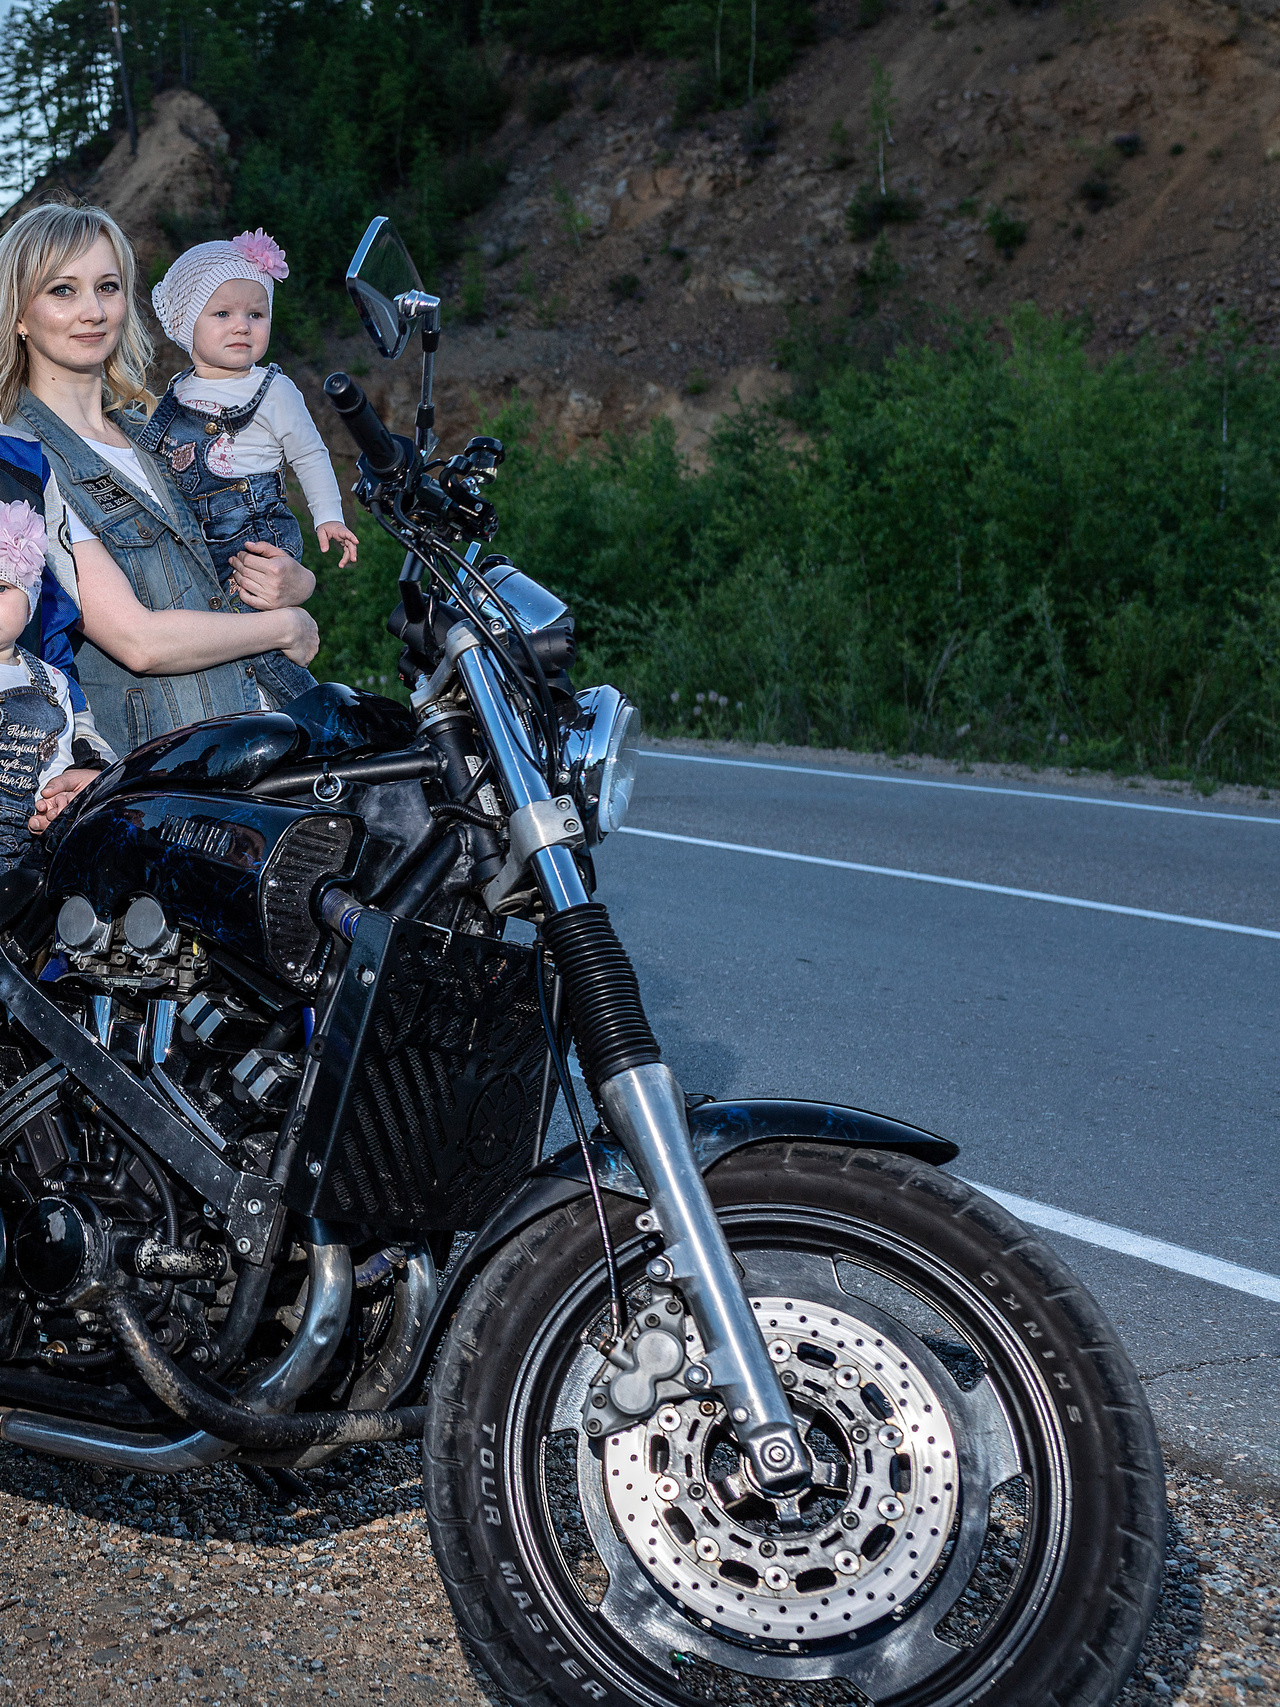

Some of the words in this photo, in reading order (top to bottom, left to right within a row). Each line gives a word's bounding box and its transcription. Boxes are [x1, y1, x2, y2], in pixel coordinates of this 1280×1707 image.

[96, 476, 112, 488] TR
[95, 492, 116, 503] FUCK
[114, 494, 134, 506] ECO
[160, 813, 233, 857] YAMAHA
[980, 1271, 1083, 1424] SHINKO
[479, 1422, 503, 1527] TOUR
[498, 1560, 609, 1702] MASTER
